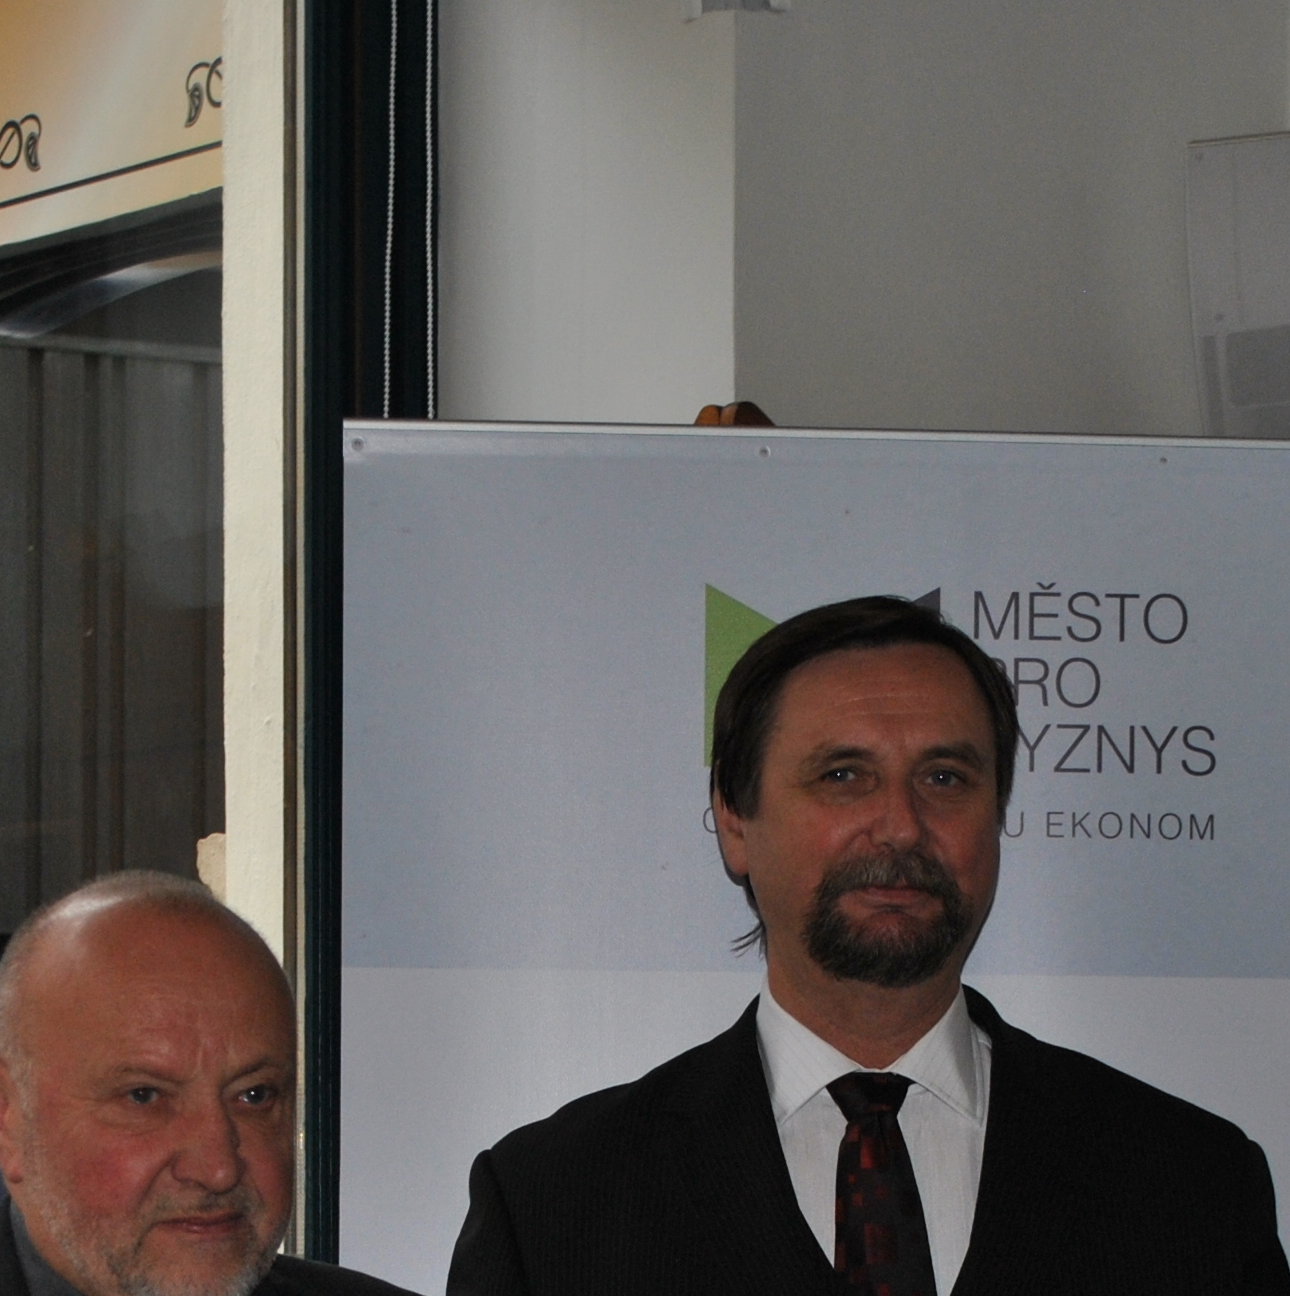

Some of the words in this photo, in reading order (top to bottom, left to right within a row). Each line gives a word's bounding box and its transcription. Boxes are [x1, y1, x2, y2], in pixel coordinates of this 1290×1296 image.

[973, 581, 1188, 644] MĚSTO
[1018, 723, 1217, 777] YZNYS
[1046, 811, 1215, 841] EKONOM
